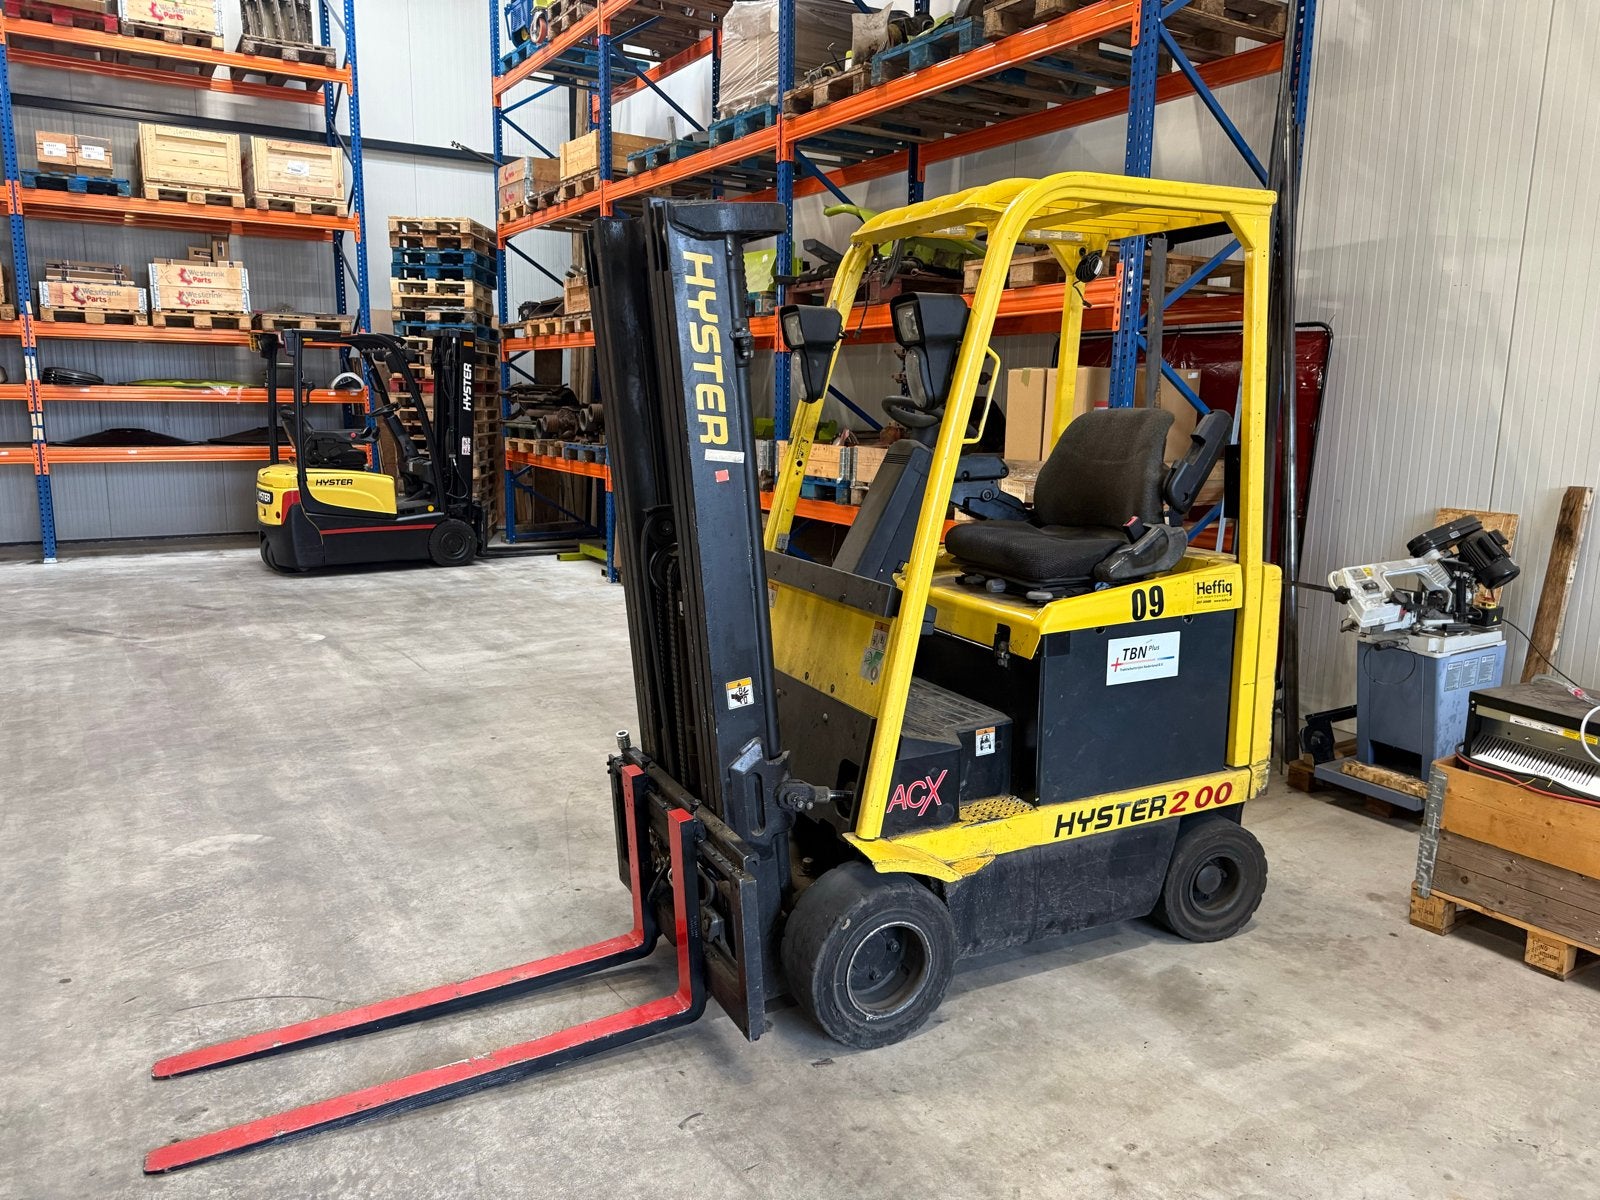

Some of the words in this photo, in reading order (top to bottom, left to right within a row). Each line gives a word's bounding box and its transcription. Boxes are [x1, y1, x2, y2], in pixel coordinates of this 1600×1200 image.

[164, 11, 184, 21] Parts
[188, 269, 225, 278] Westerink
[192, 276, 212, 284] Parts
[81, 287, 122, 297] Westerink
[186, 291, 223, 299] Westerink
[86, 295, 107, 303] Parts
[683, 251, 728, 445] HYSTER
[462, 362, 472, 411] HYSTER
[315, 478, 353, 486] HYSTER
[1197, 579, 1233, 596] Heffiq
[1132, 585, 1164, 620] 09
[1122, 645, 1148, 661] TBN
[886, 769, 948, 816] ACX
[1054, 794, 1167, 838] HYSTER
[1168, 781, 1233, 815] 200
